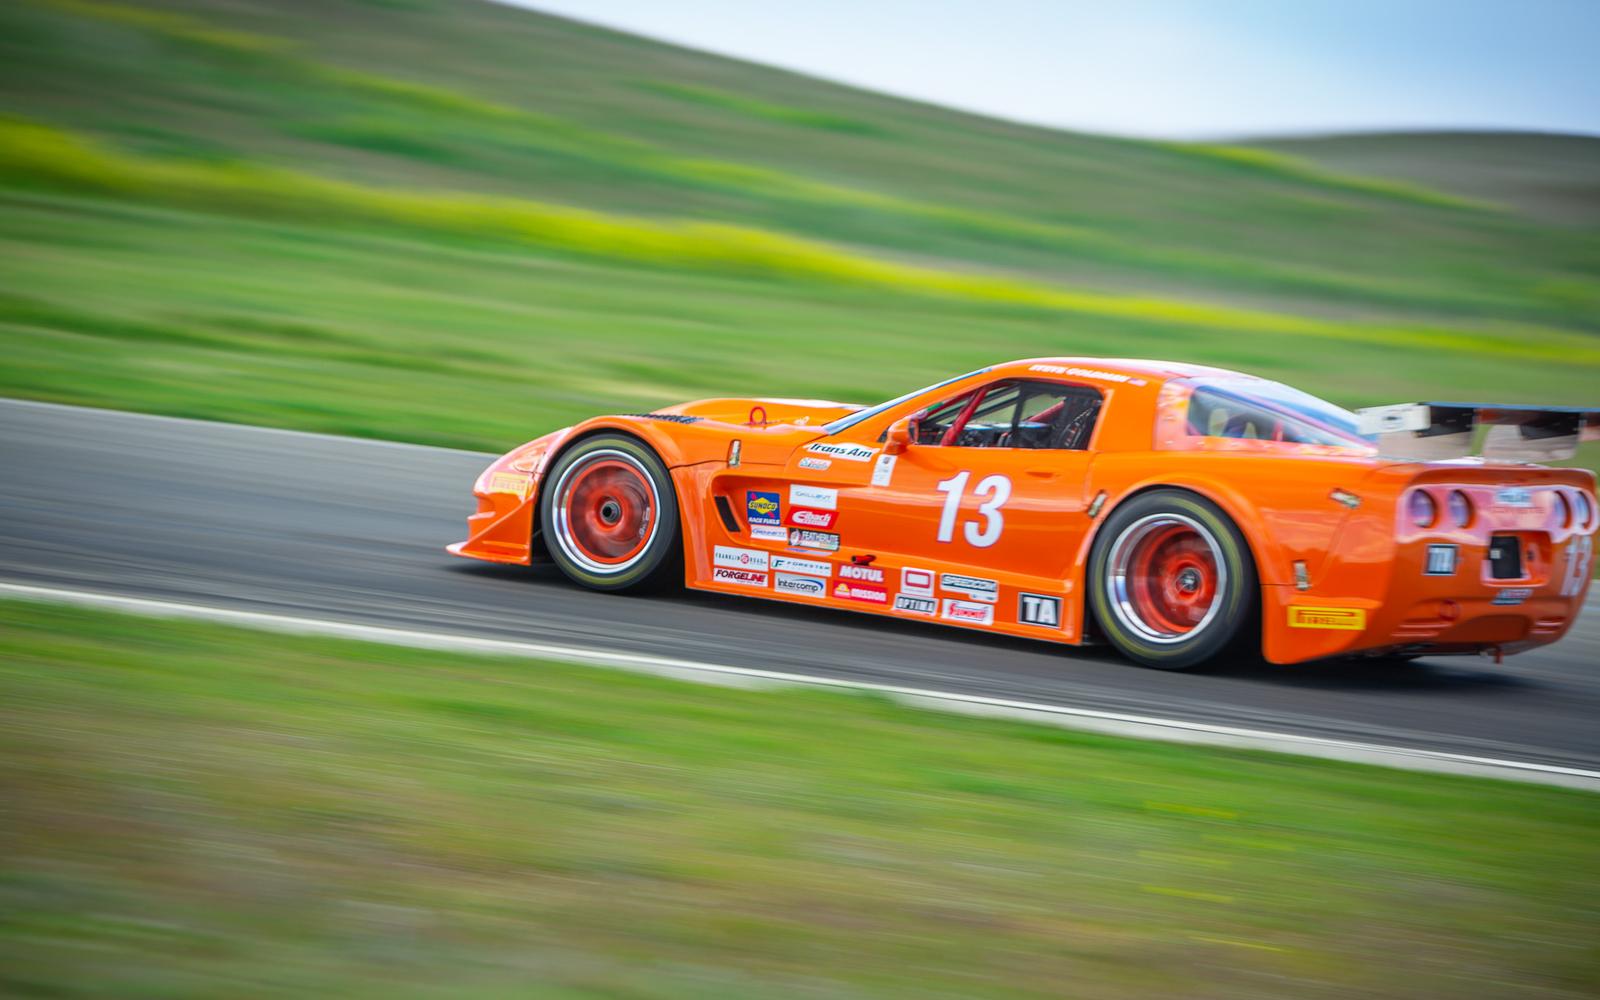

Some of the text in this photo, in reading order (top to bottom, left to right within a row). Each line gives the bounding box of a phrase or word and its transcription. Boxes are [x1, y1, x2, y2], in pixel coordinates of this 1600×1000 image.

[811, 443, 872, 458] Trans Am
[749, 501, 777, 511] SUNOCO
[936, 470, 1011, 548] 13
[715, 569, 766, 582] FORGELINE
[839, 565, 884, 582] MOTUL
[851, 588, 886, 602] MISSION
[896, 597, 935, 613] OPTIMA
[1023, 596, 1058, 625] TA
